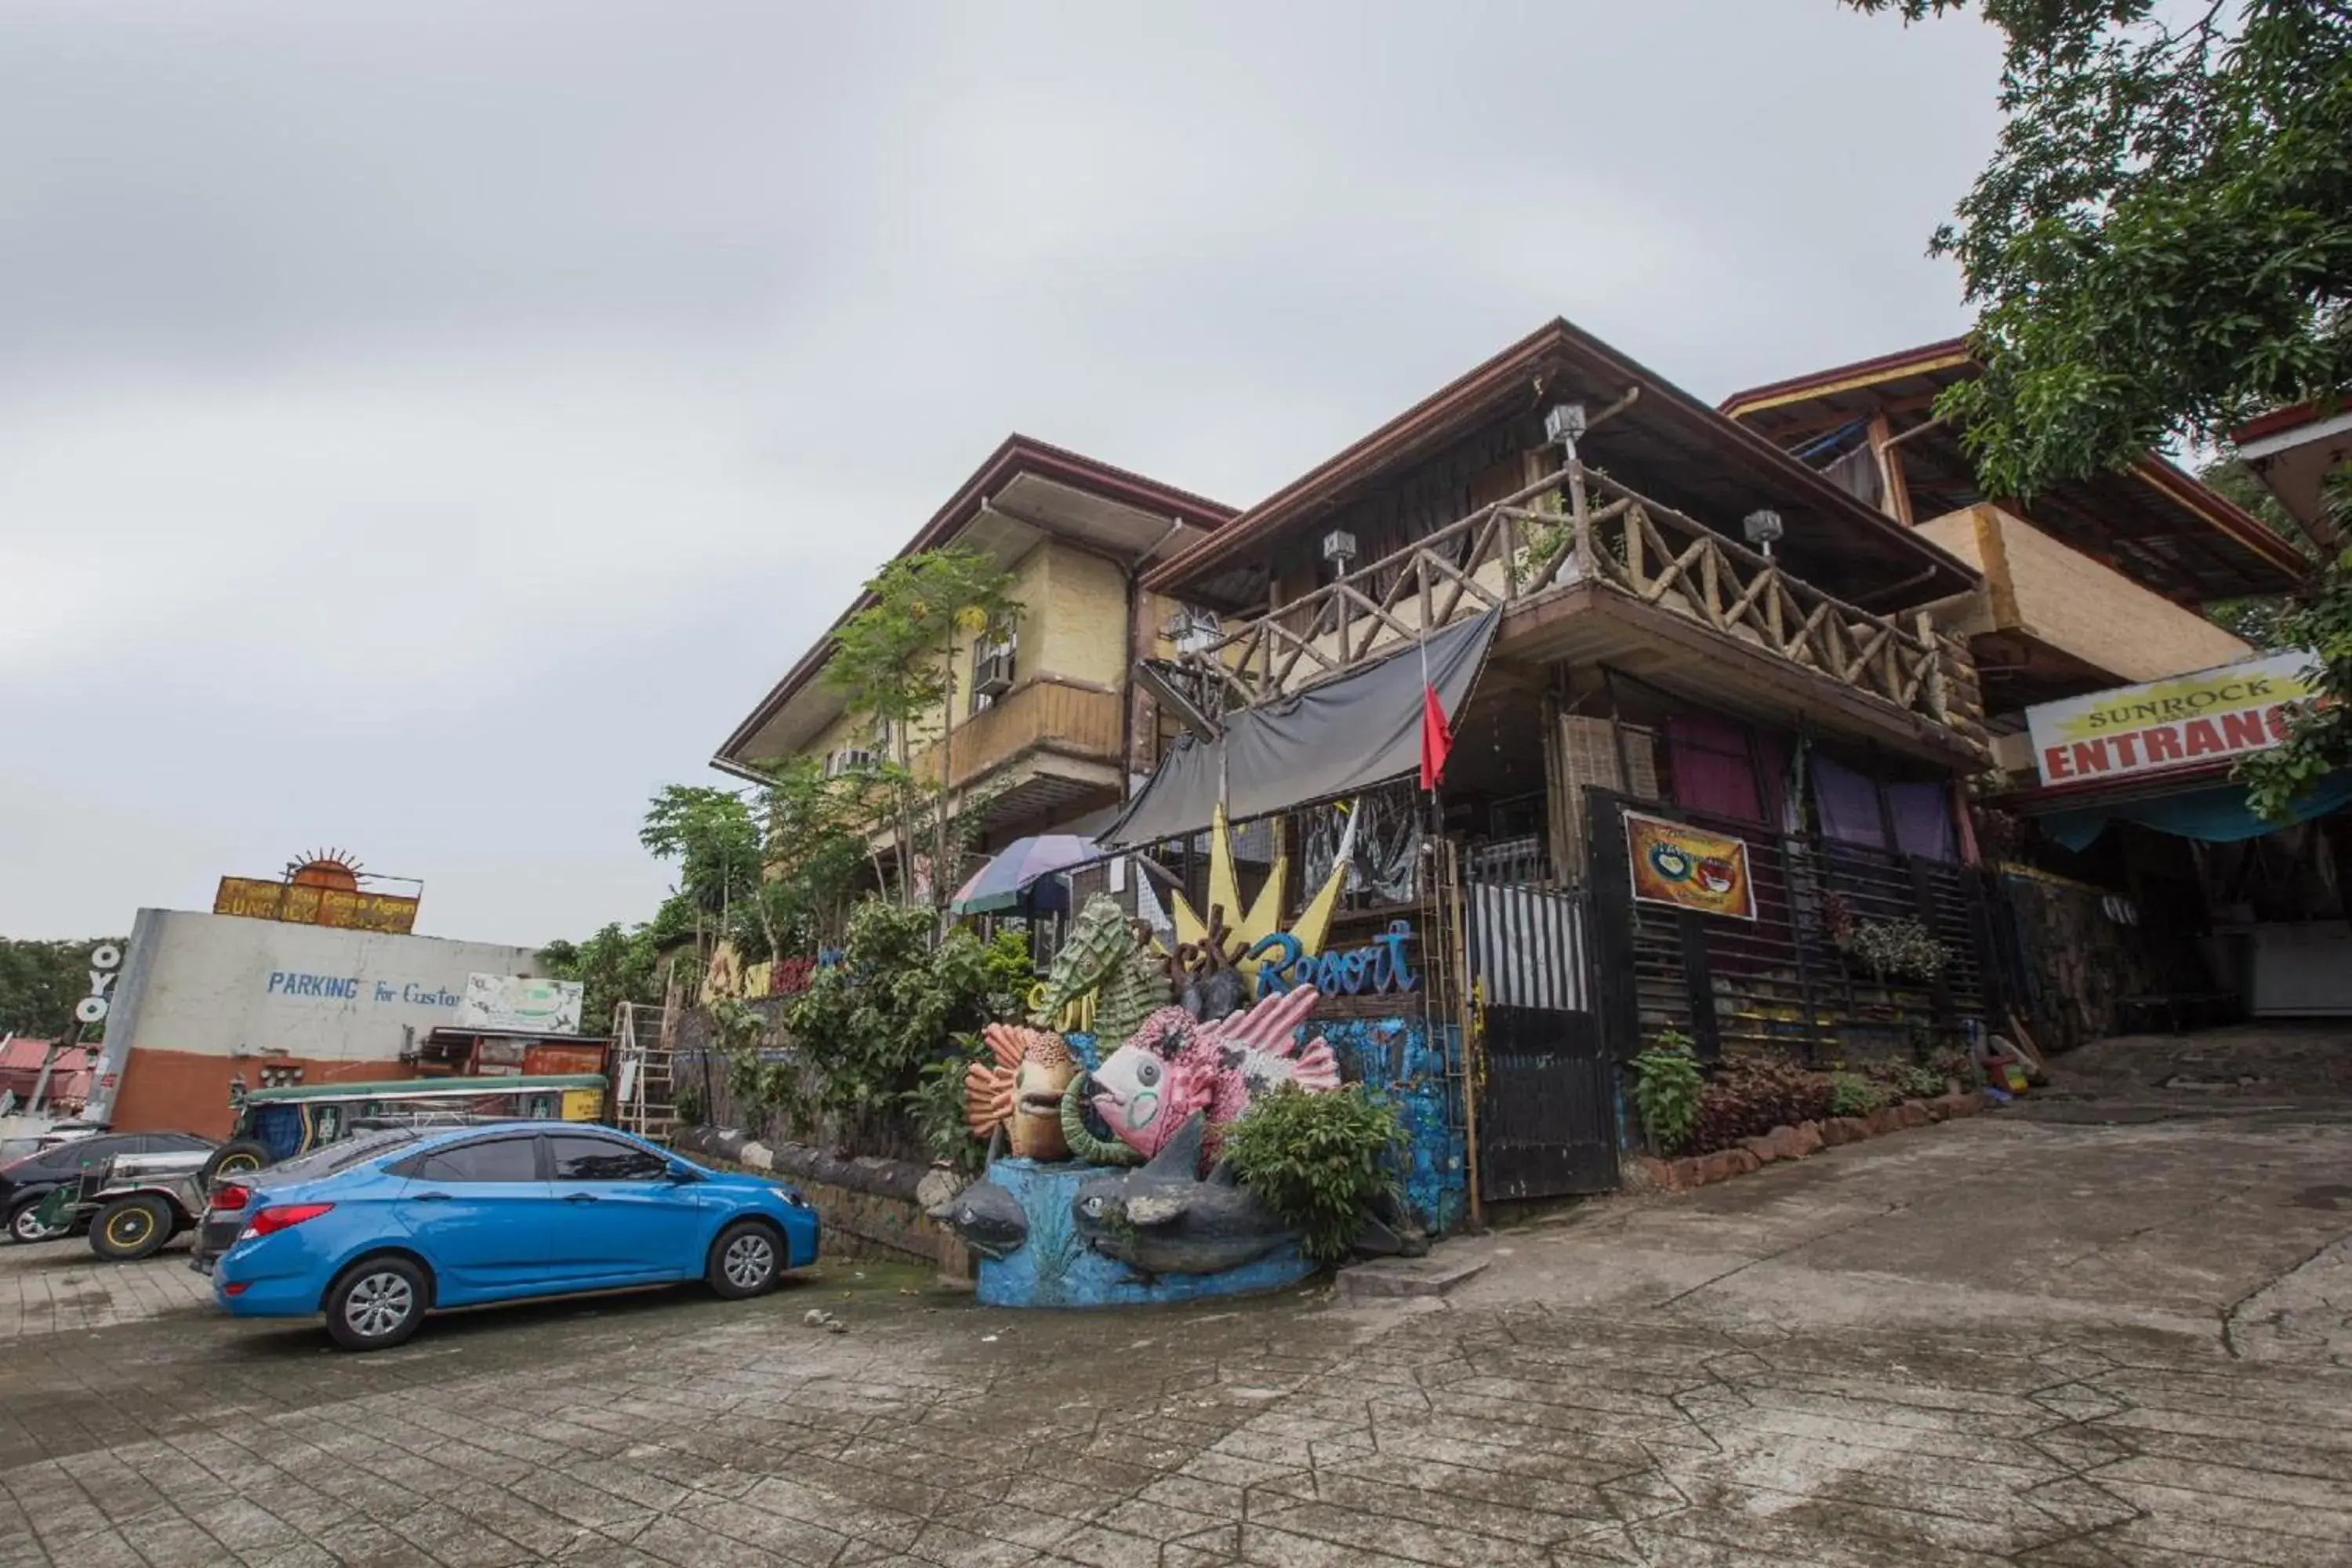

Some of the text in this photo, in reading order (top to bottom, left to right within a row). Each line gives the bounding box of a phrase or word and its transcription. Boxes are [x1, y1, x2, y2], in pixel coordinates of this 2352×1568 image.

[2089, 679, 2273, 729] SUNROCK
[2044, 696, 2344, 780] ENTRANC
[267, 971, 359, 1000] PARKING
[403, 982, 462, 1007] Custo
